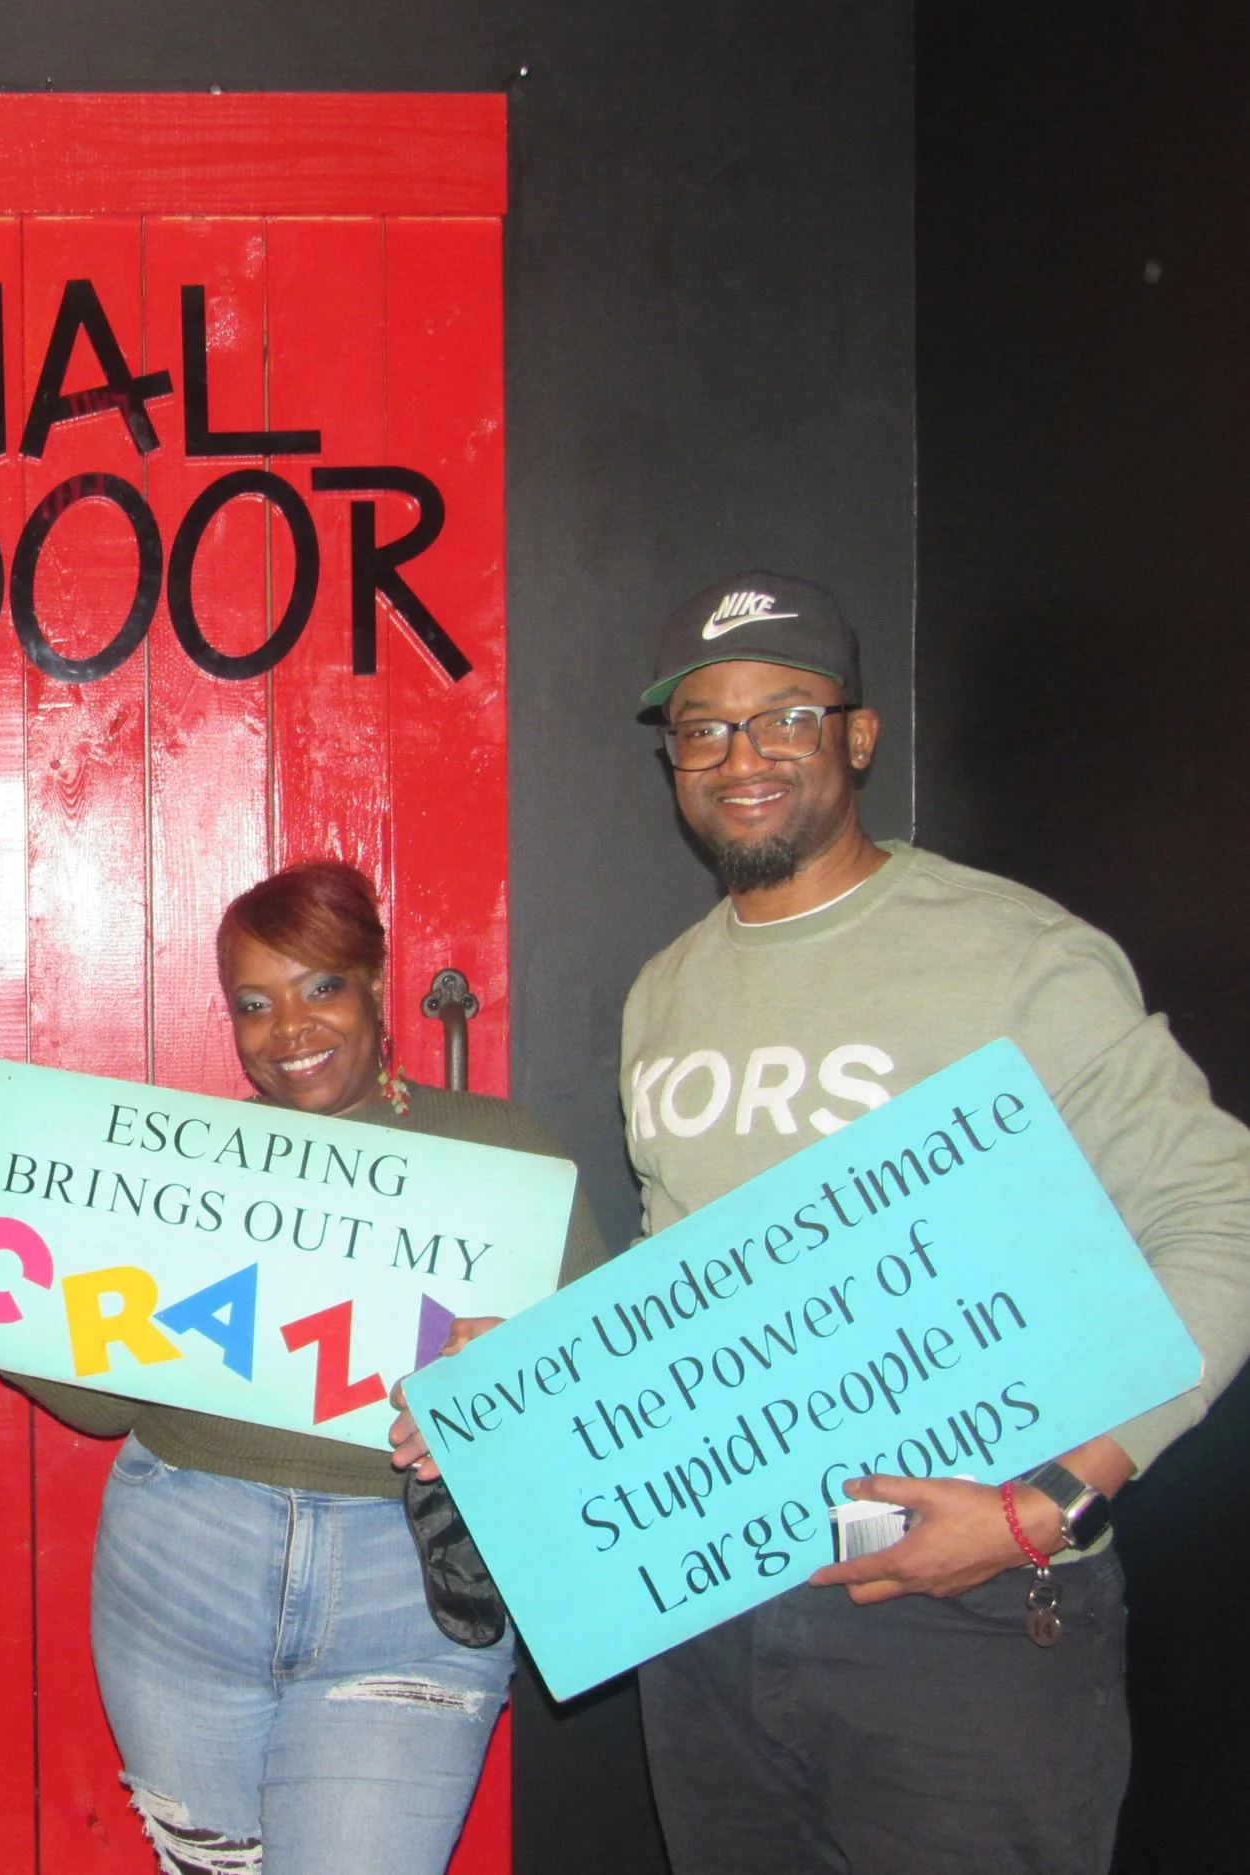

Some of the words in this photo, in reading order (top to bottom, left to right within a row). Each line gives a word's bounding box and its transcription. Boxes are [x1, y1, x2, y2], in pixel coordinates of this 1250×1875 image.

[714, 591, 776, 621] NIKE
[104, 1104, 409, 1198] ESCAPING
[631, 1044, 895, 1142] KORS
[3, 1152, 225, 1233] BRINGS
[243, 1199, 373, 1261] OUT
[391, 1227, 494, 1283] MY
[429, 1337, 584, 1455] Never
[591, 1091, 1031, 1358] Underestimate
[571, 1389, 672, 1462] the
[667, 1275, 858, 1411] Power
[876, 1218, 938, 1298] of
[580, 1413, 769, 1552] Stupid
[760, 1326, 962, 1456] People
[957, 1291, 1028, 1350] in
[637, 1499, 818, 1616] Large
